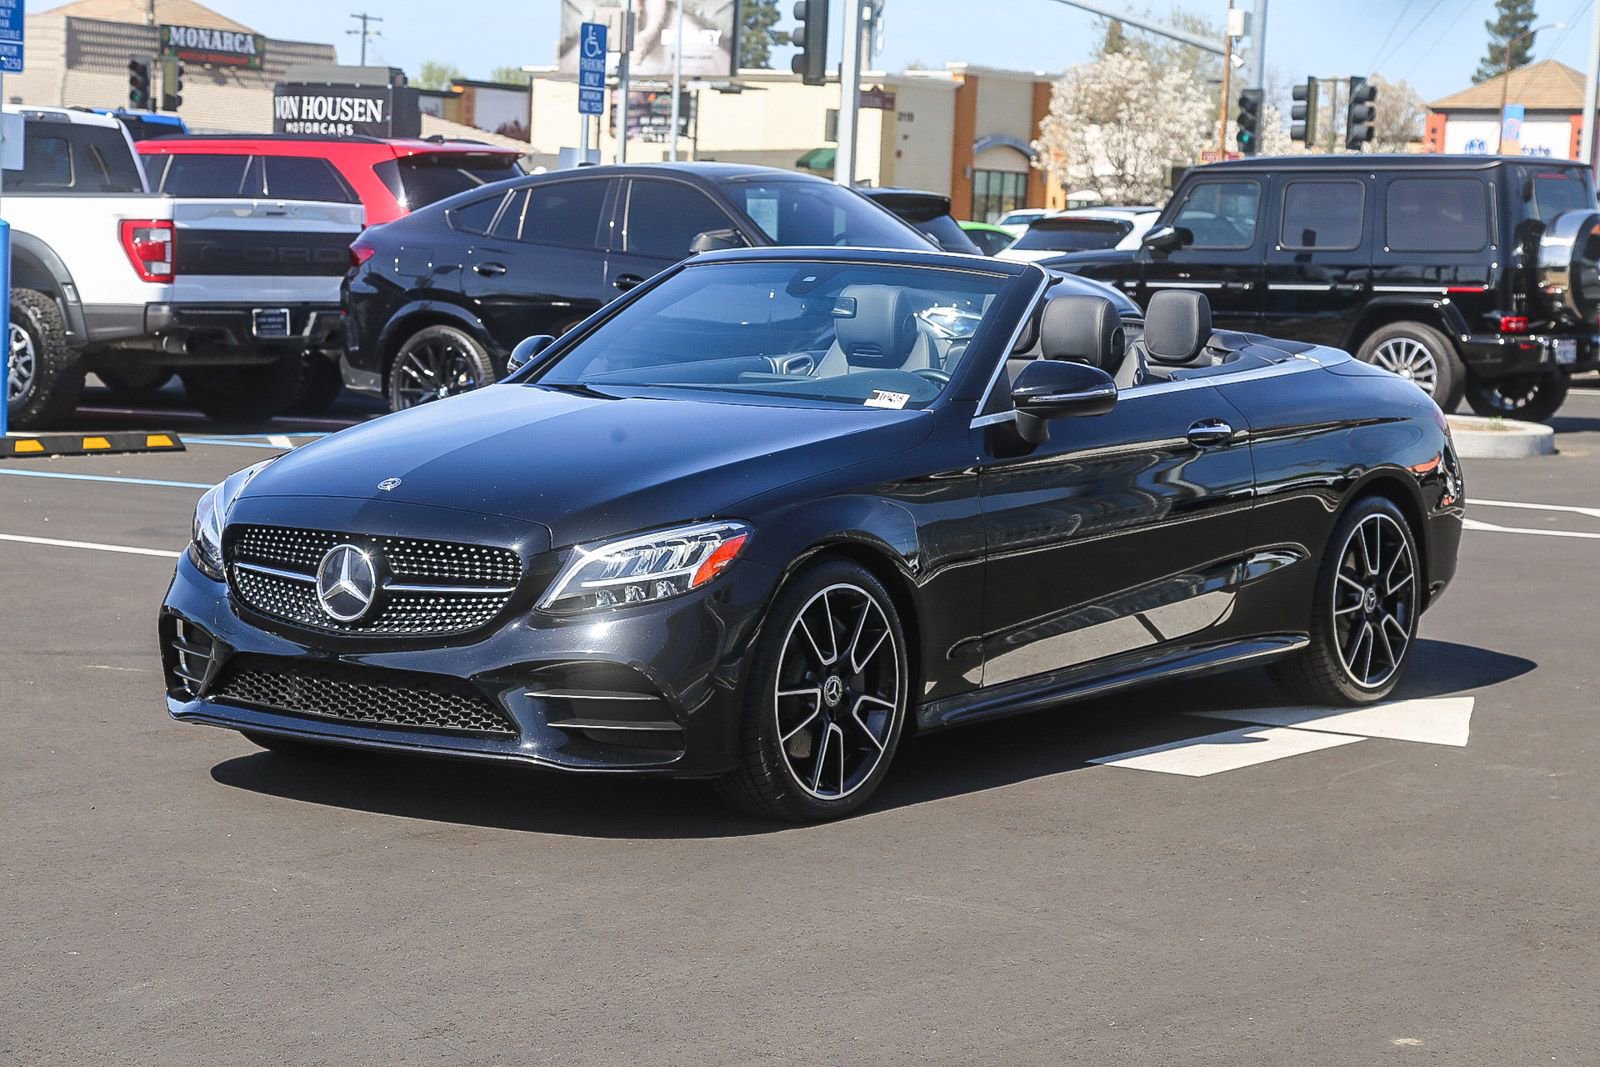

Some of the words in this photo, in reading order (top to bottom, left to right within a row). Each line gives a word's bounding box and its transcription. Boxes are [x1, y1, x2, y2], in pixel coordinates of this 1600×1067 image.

[169, 26, 256, 54] MONARCA
[301, 96, 384, 123] HOUSEN
[285, 122, 354, 136] MOTORCARS
